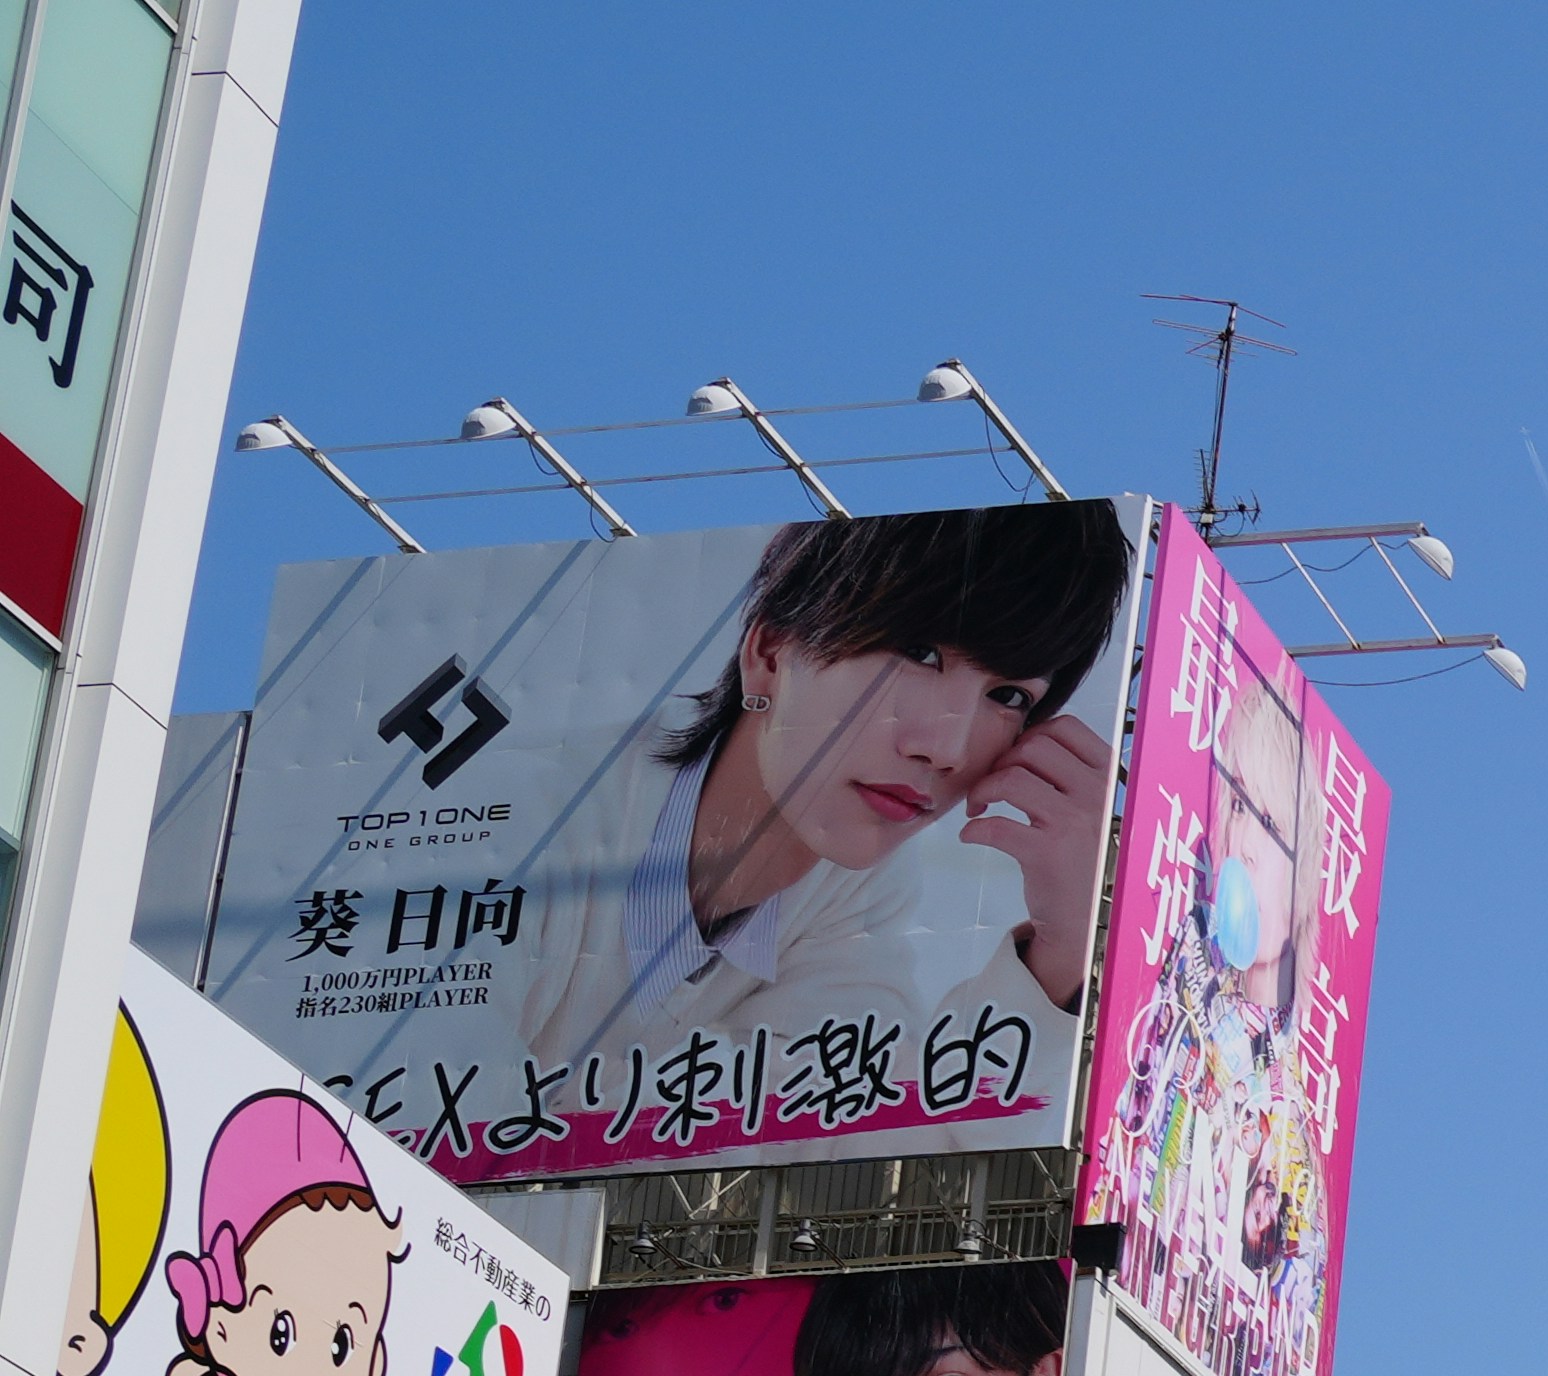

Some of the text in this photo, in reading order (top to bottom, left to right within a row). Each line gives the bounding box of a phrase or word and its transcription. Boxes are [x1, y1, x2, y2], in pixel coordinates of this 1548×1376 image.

[348, 831, 491, 852] ONE GROUP
[284, 879, 528, 963] 葵 日向
[1299, 731, 1367, 1156] 最高
[295, 987, 490, 1020] 指名230組PLAYER
[302, 961, 493, 995] 1,000万円PLAYER
[435, 1216, 551, 1324] 総合不動産業の
